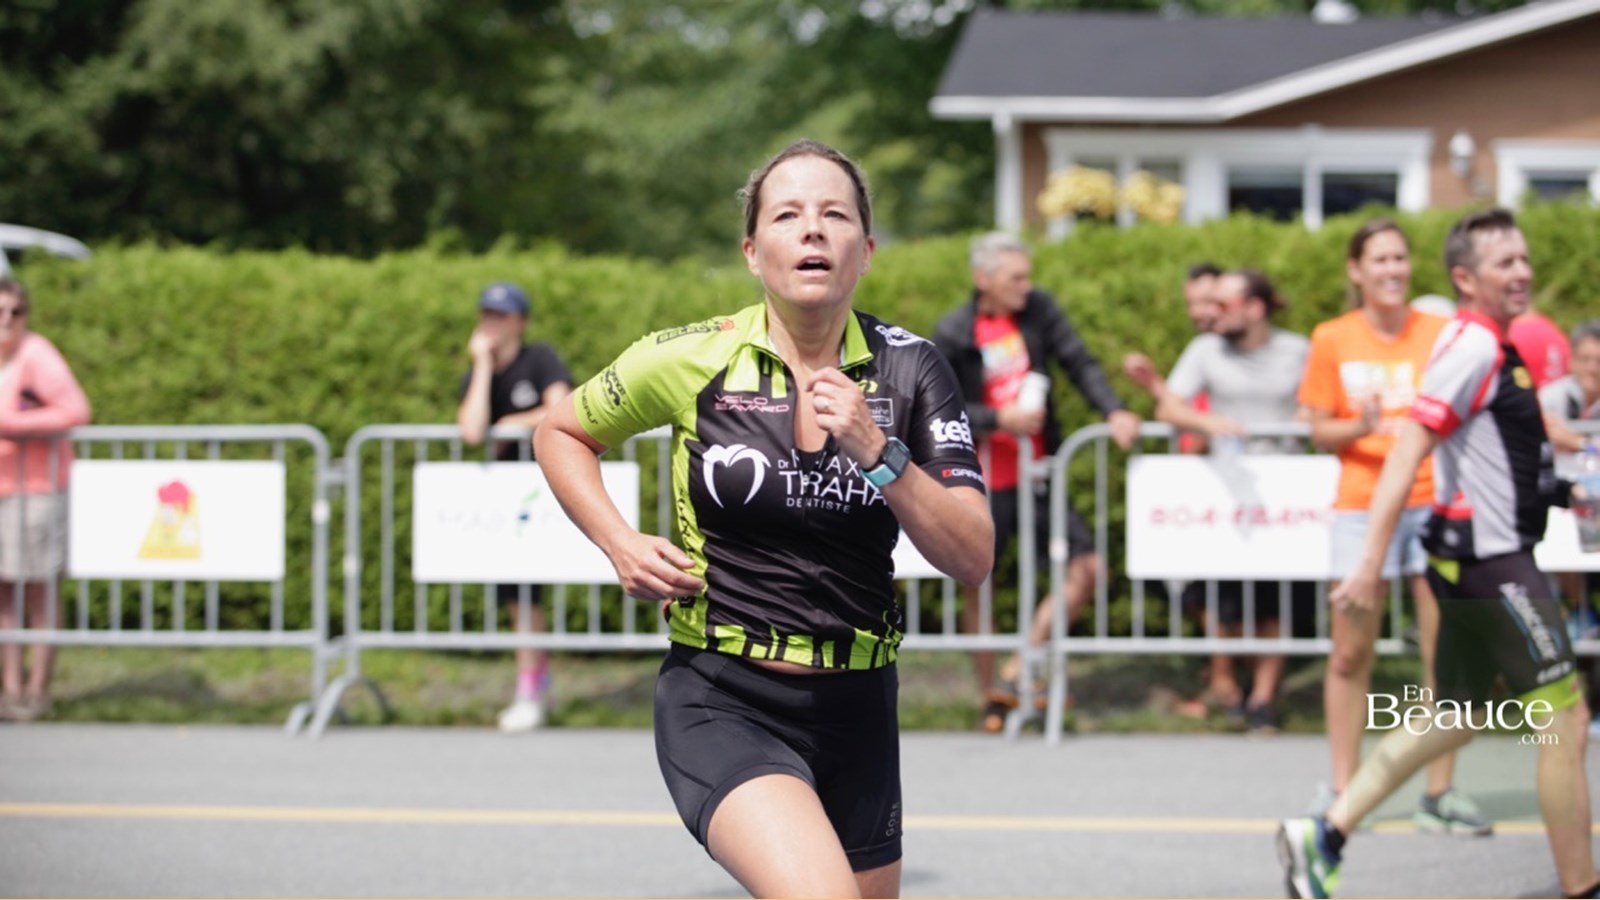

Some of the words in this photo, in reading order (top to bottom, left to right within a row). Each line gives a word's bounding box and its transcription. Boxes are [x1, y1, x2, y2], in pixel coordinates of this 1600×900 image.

[714, 393, 769, 406] VELO
[777, 459, 790, 469] Dr
[786, 497, 852, 514] DENTISTE
